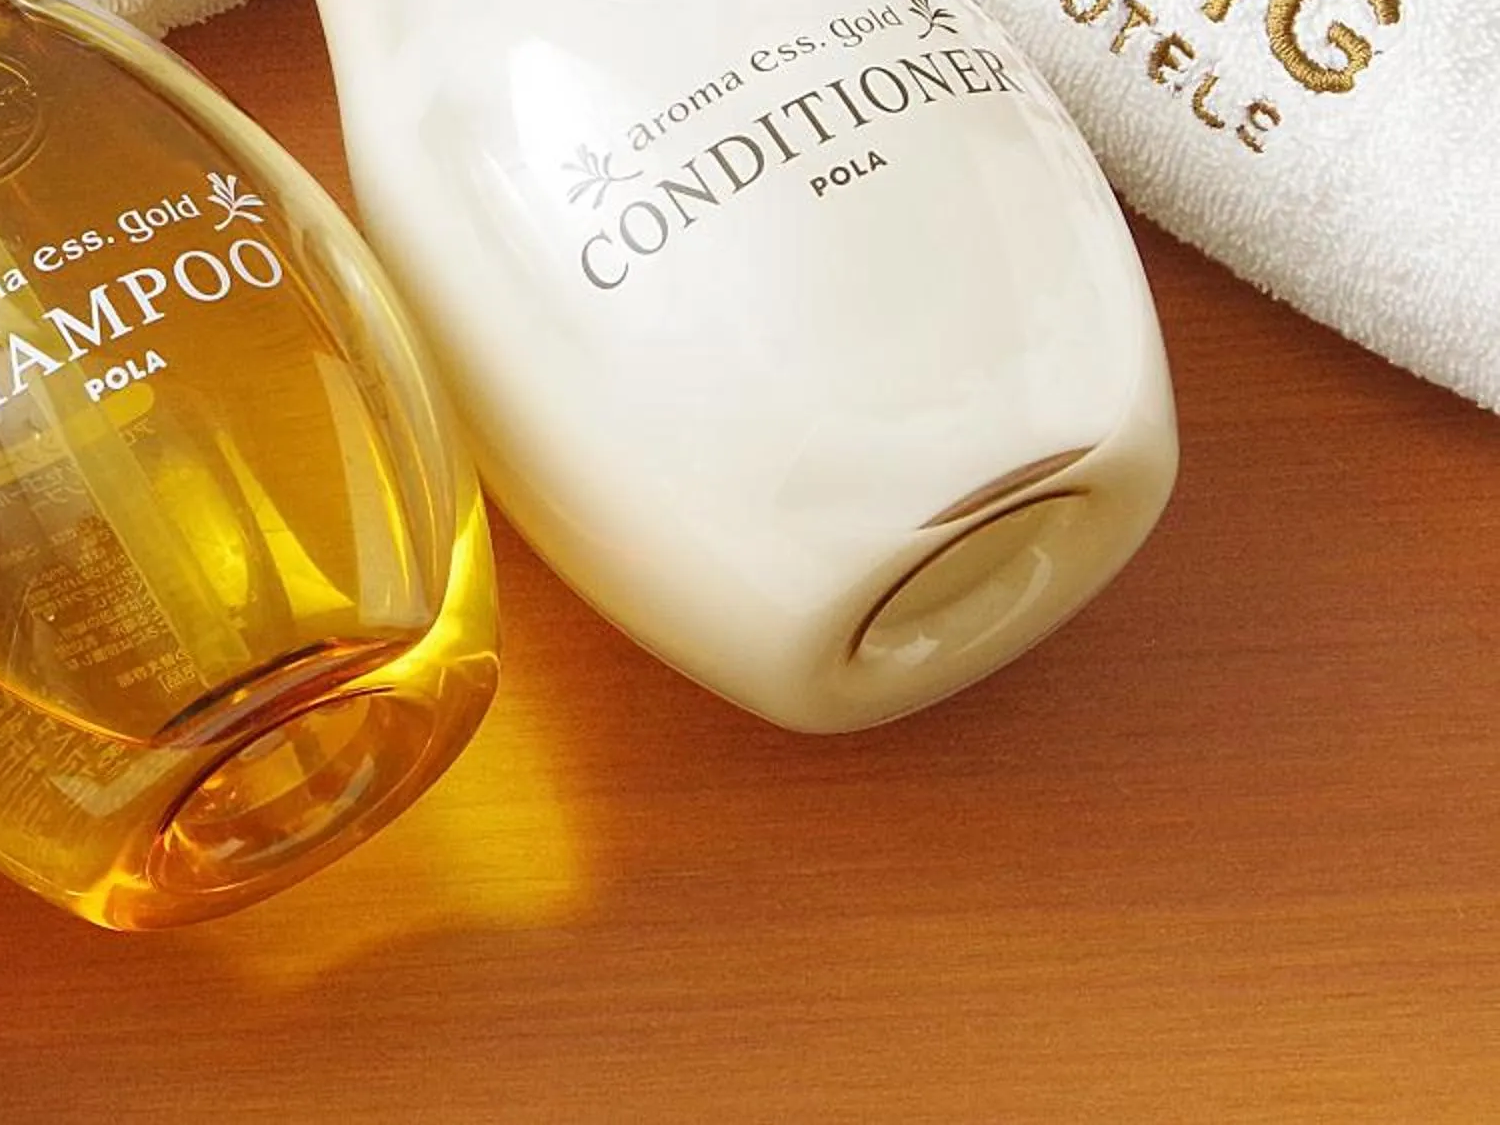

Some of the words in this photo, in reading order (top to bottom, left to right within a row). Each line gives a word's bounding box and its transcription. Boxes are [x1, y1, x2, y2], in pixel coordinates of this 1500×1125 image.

[627, 69, 745, 152] aroma
[750, 35, 826, 73] ess.
[829, 4, 904, 48] gold
[581, 47, 1024, 290] CONDITIONER
[810, 150, 888, 198] POLA
[32, 228, 115, 273] ess.
[118, 193, 201, 244] gold
[85, 348, 168, 403] POLA
